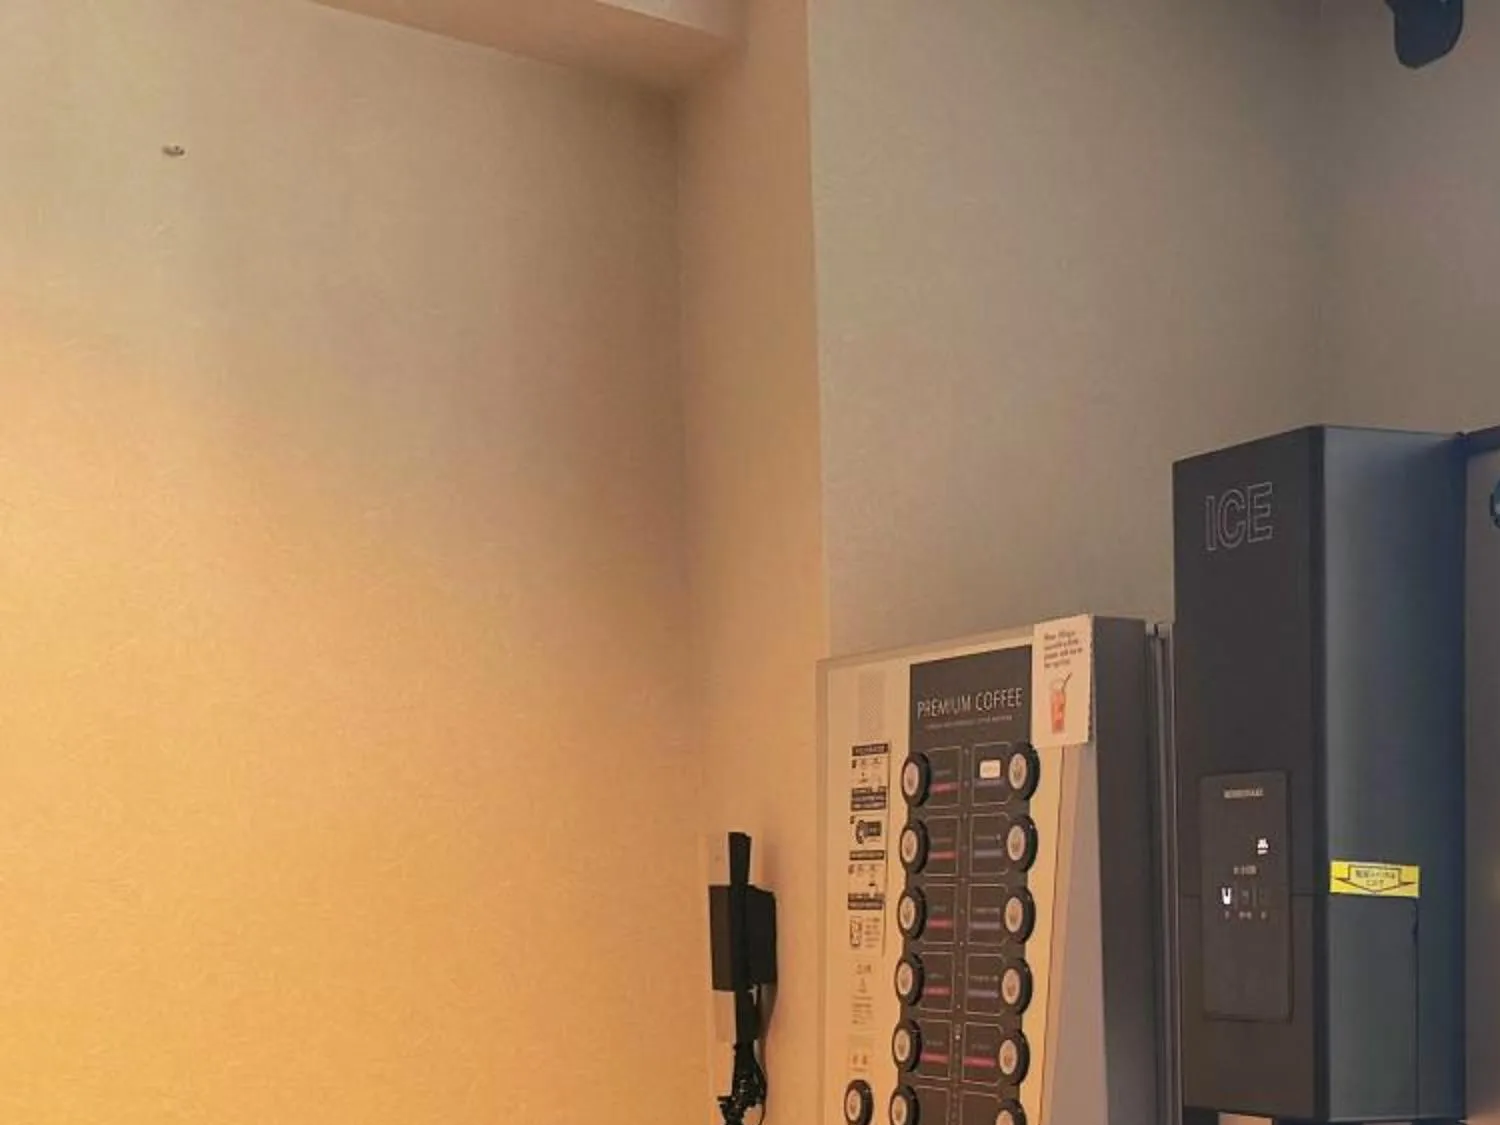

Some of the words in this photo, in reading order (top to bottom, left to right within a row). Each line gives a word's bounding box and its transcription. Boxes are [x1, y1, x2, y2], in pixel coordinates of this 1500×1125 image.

[1205, 481, 1273, 550] ICE
[917, 694, 971, 720] PREMIUM
[975, 687, 1024, 713] COFFEE
